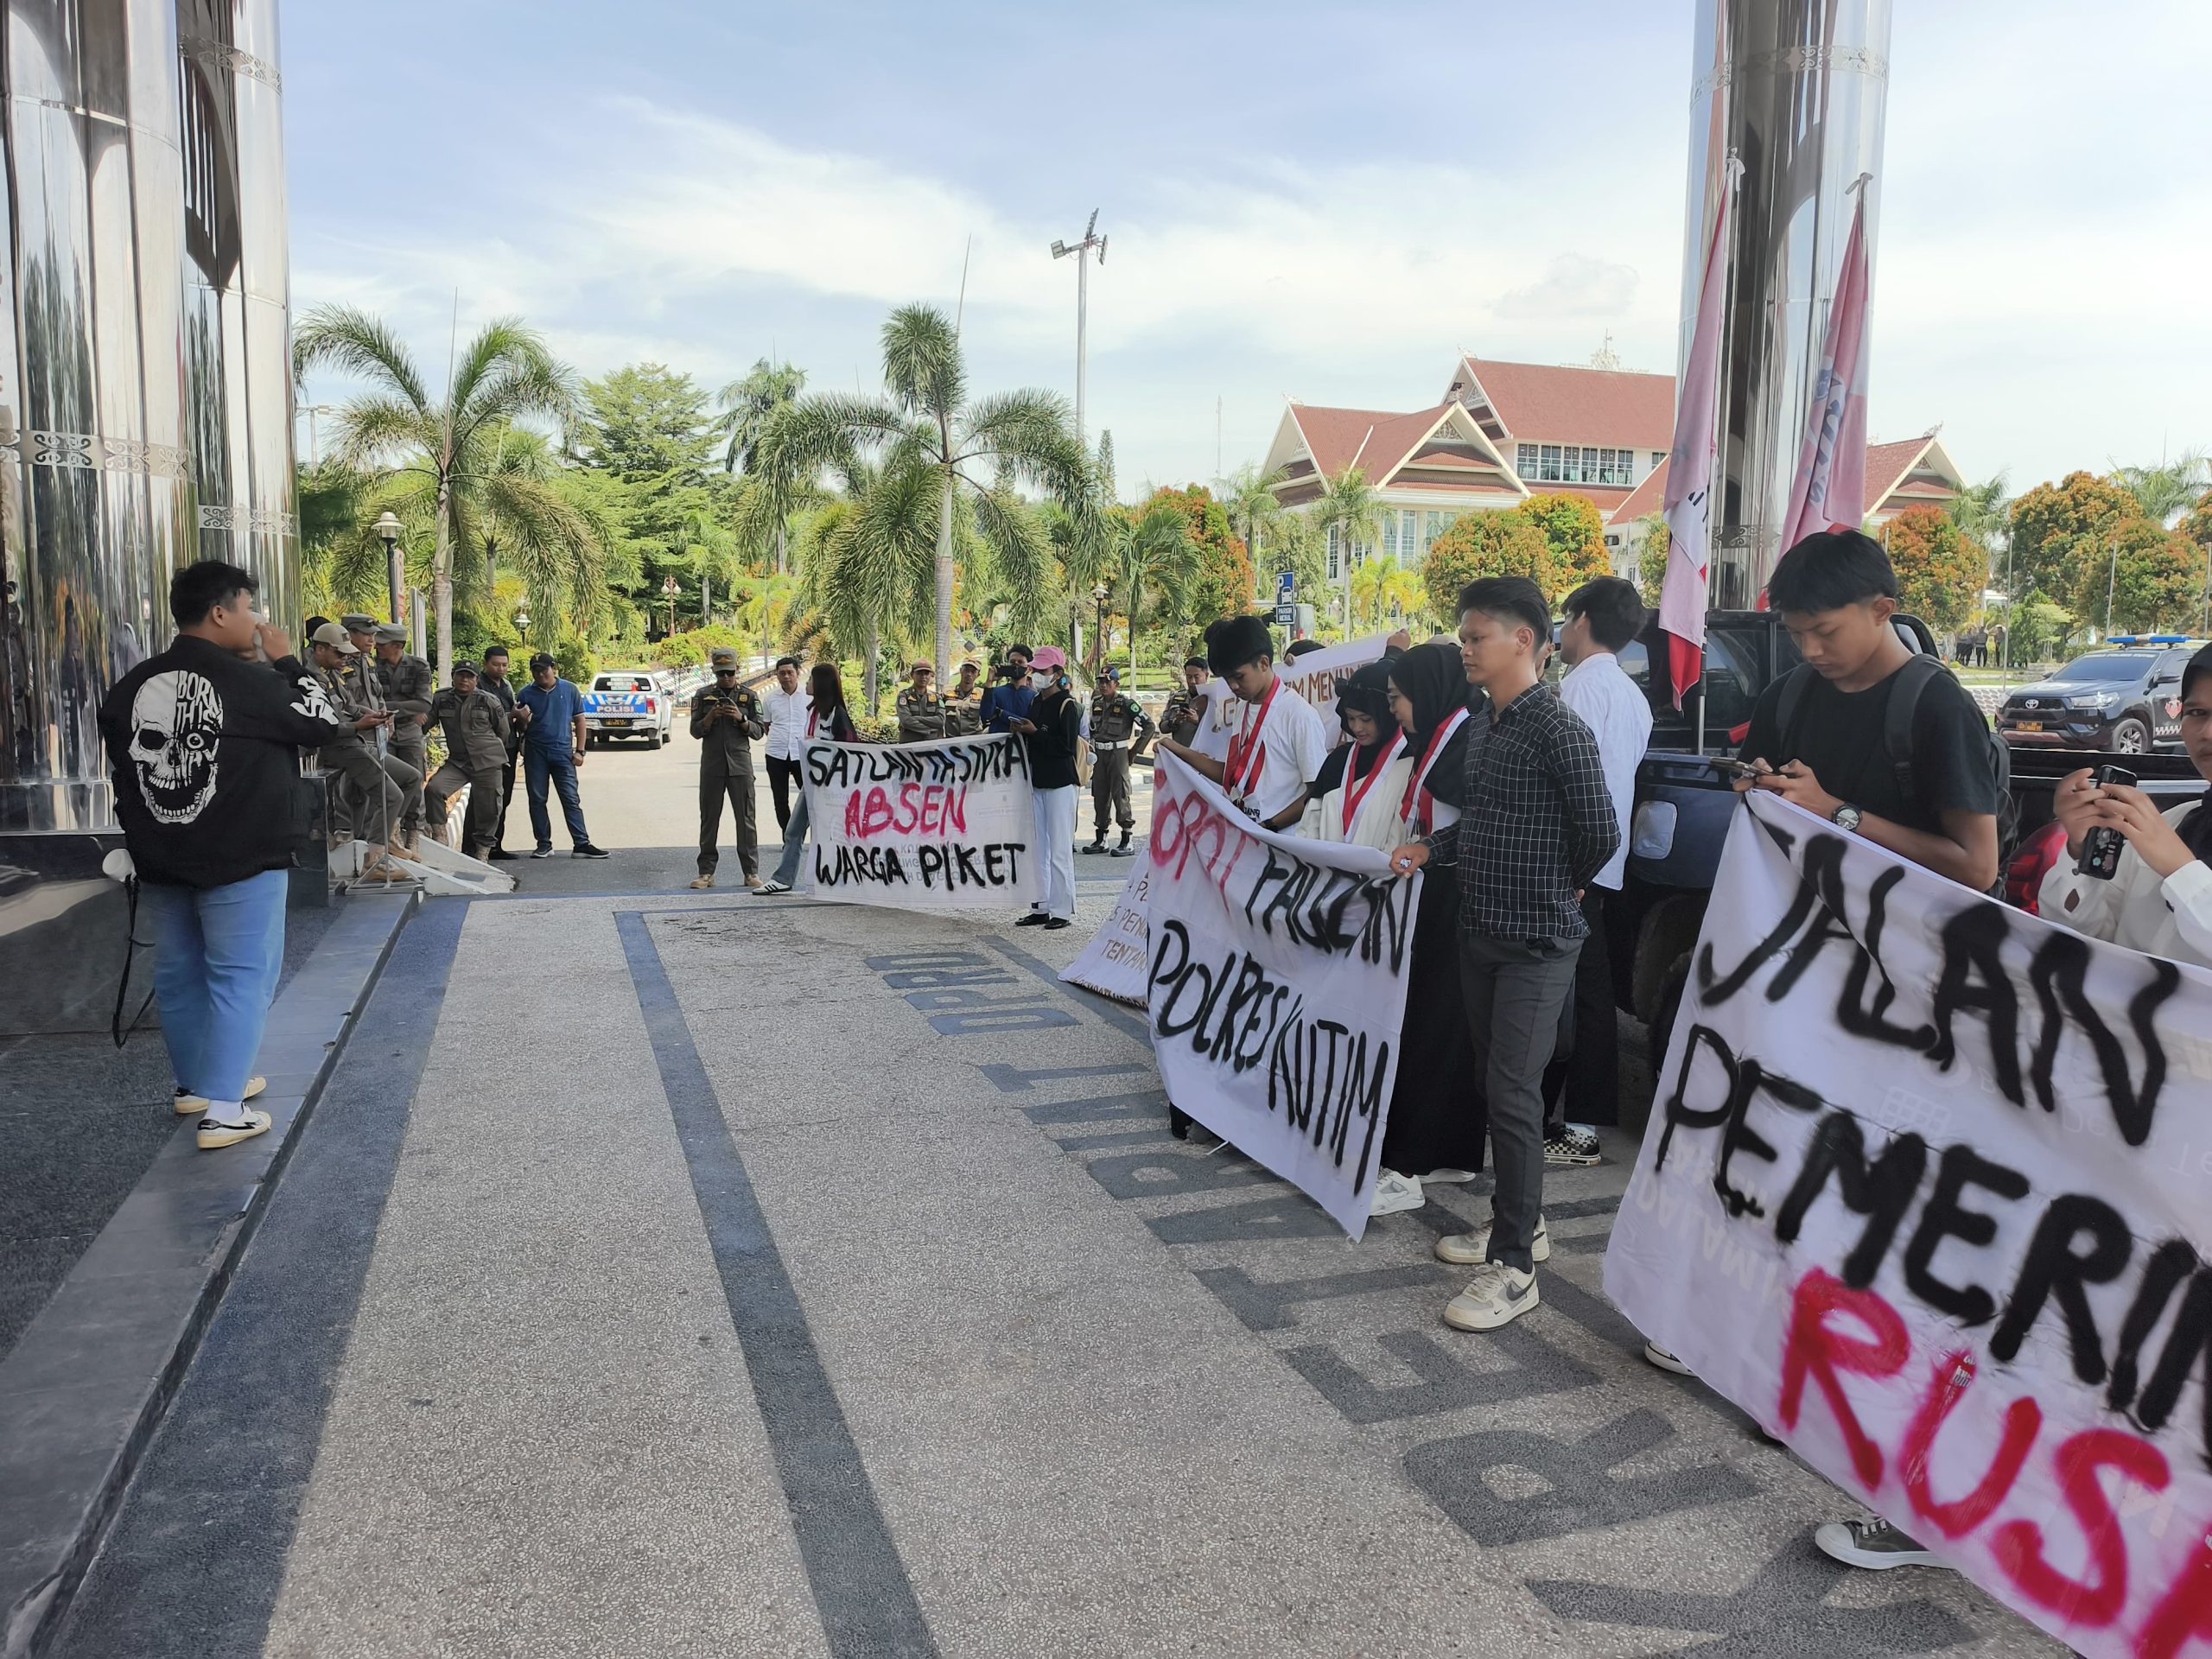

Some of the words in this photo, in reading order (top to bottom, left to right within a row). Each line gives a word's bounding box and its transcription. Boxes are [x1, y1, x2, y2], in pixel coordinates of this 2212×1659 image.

[178, 670, 223, 715] BORN
[844, 781, 968, 840] ABSEN
[816, 842, 908, 887] WARGA
[918, 842, 1026, 891] PIKET
[1698, 817, 2181, 1147] JALAN
[1147, 919, 1288, 1073] POLRES
[1268, 994, 1389, 1197] KUTIM
